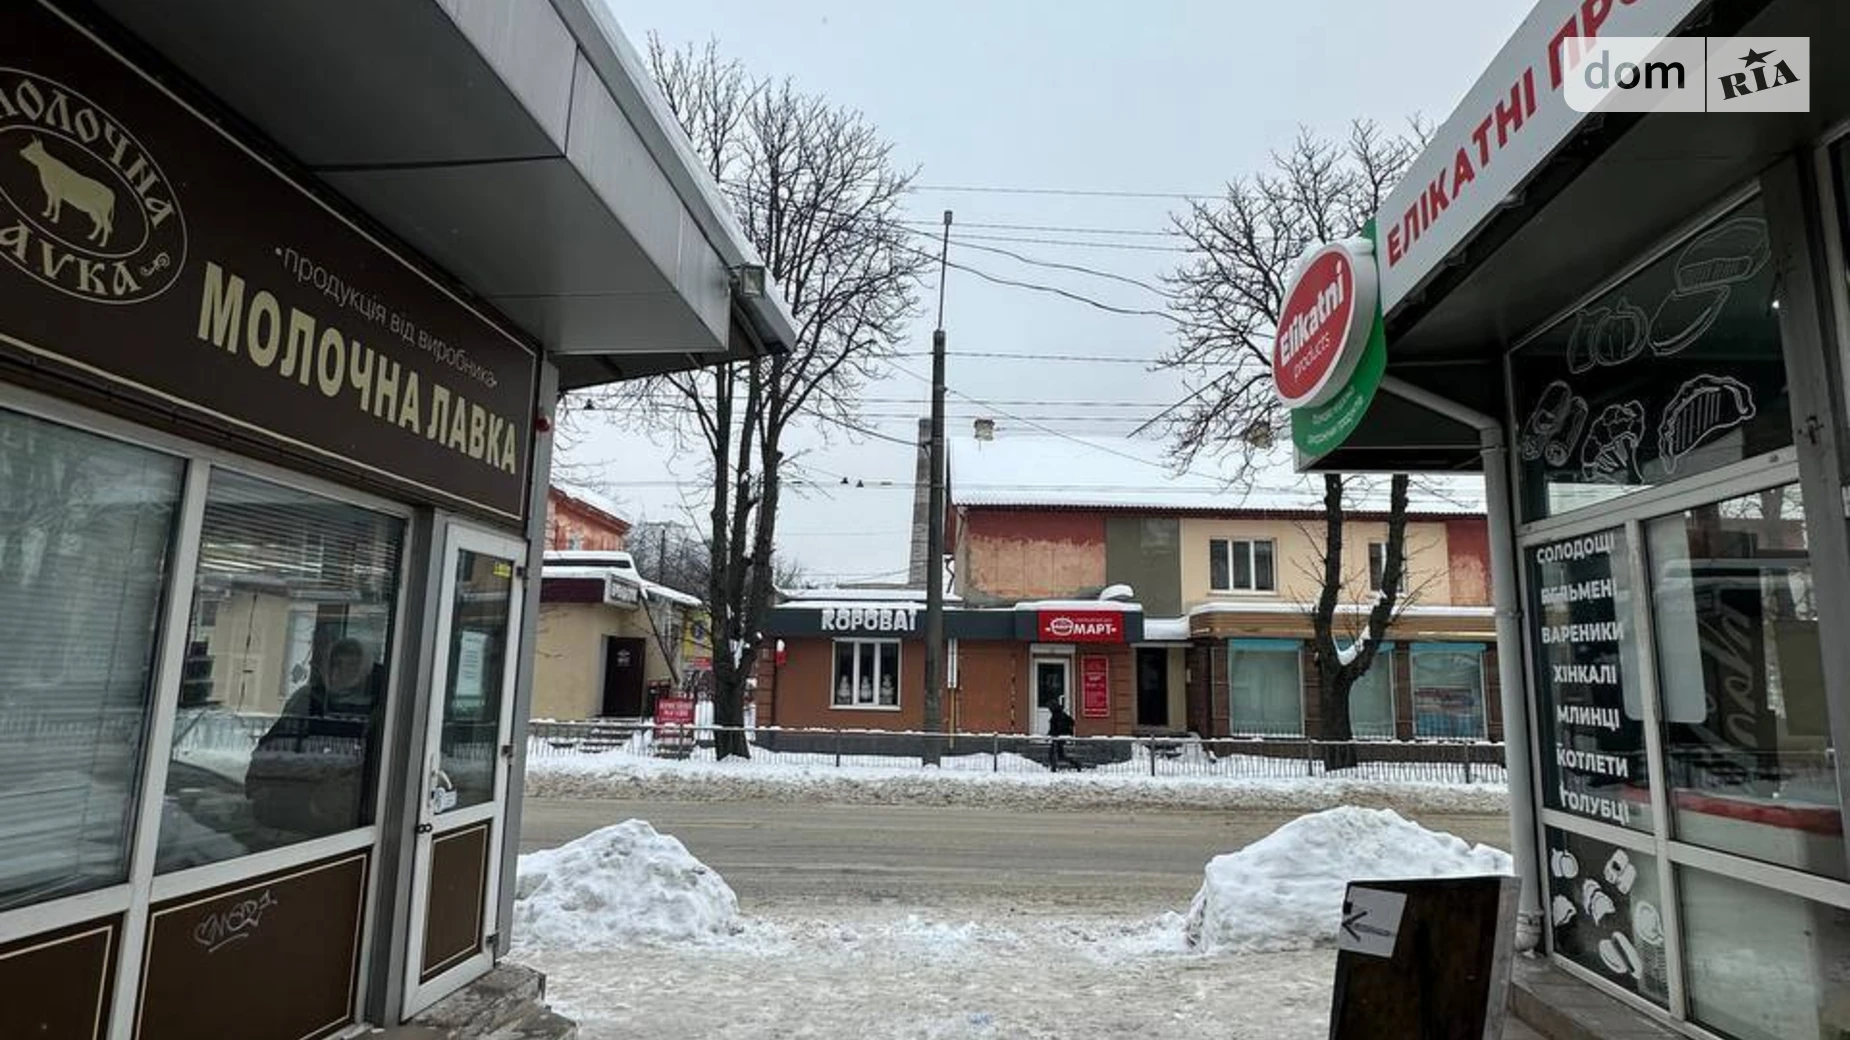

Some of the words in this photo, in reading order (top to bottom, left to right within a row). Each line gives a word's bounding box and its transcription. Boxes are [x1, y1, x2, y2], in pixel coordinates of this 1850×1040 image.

[1387, 67, 1535, 267] ЕЛІКАТНІ
[1547, 0, 1638, 91] ПР
[389, 312, 415, 343] від
[1279, 260, 1344, 366] Elikatni
[198, 261, 420, 434] МОЛОЧНА
[427, 384, 516, 474] ЛАВКА
[1294, 332, 1331, 382] products
[1537, 532, 1614, 564] СОЛОДОЩІ
[1541, 621, 1625, 644] ВАРЕНИКИ
[1553, 664, 1618, 684] ХІНКАЛІ
[1556, 705, 1620, 731] МЛИНЦІ
[1556, 748, 1628, 778] КОТЛЕТИ
[1559, 791, 1629, 825] ГОЛУБЦІ
